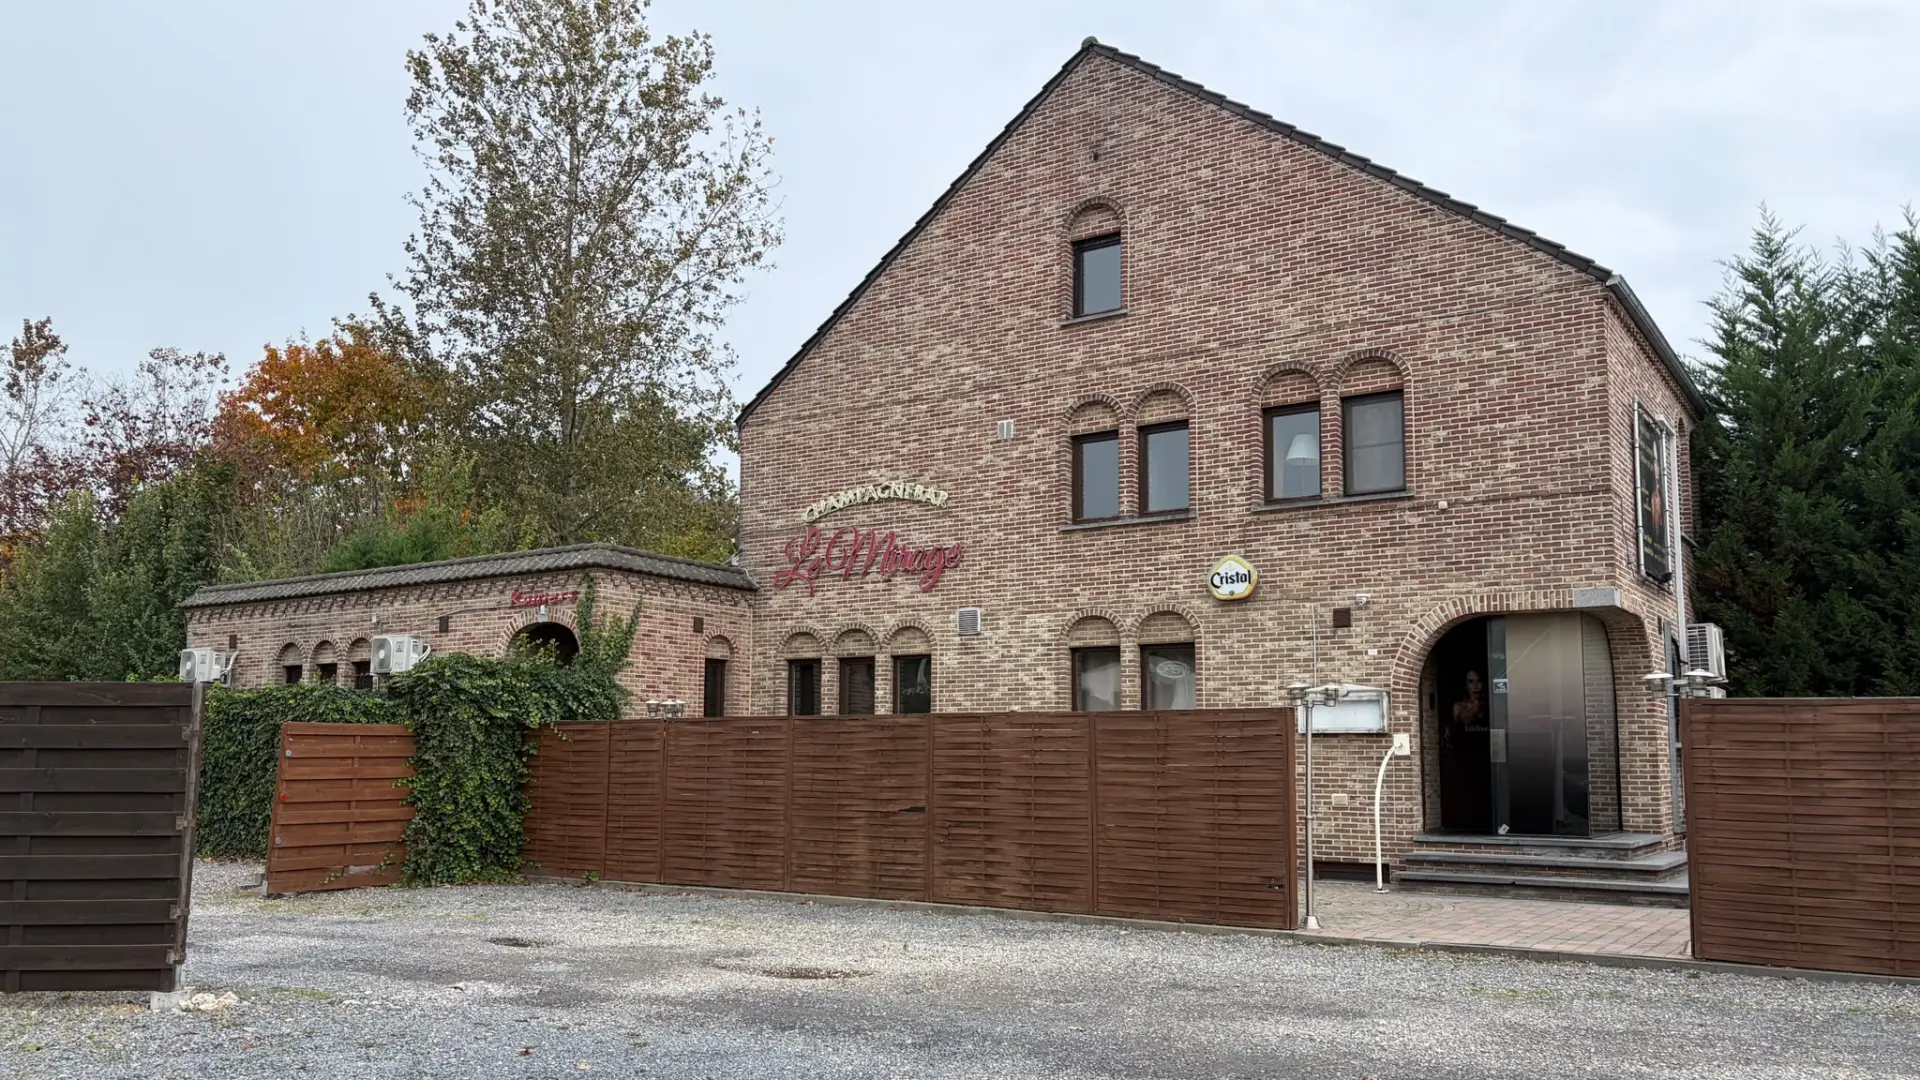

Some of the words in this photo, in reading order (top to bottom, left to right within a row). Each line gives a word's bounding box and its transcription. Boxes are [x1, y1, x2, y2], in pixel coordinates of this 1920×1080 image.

[803, 481, 949, 523] CHAMPAGNEBAR
[772, 527, 825, 597] Le
[825, 525, 963, 592] Mirage
[1210, 569, 1252, 589] Cristal
